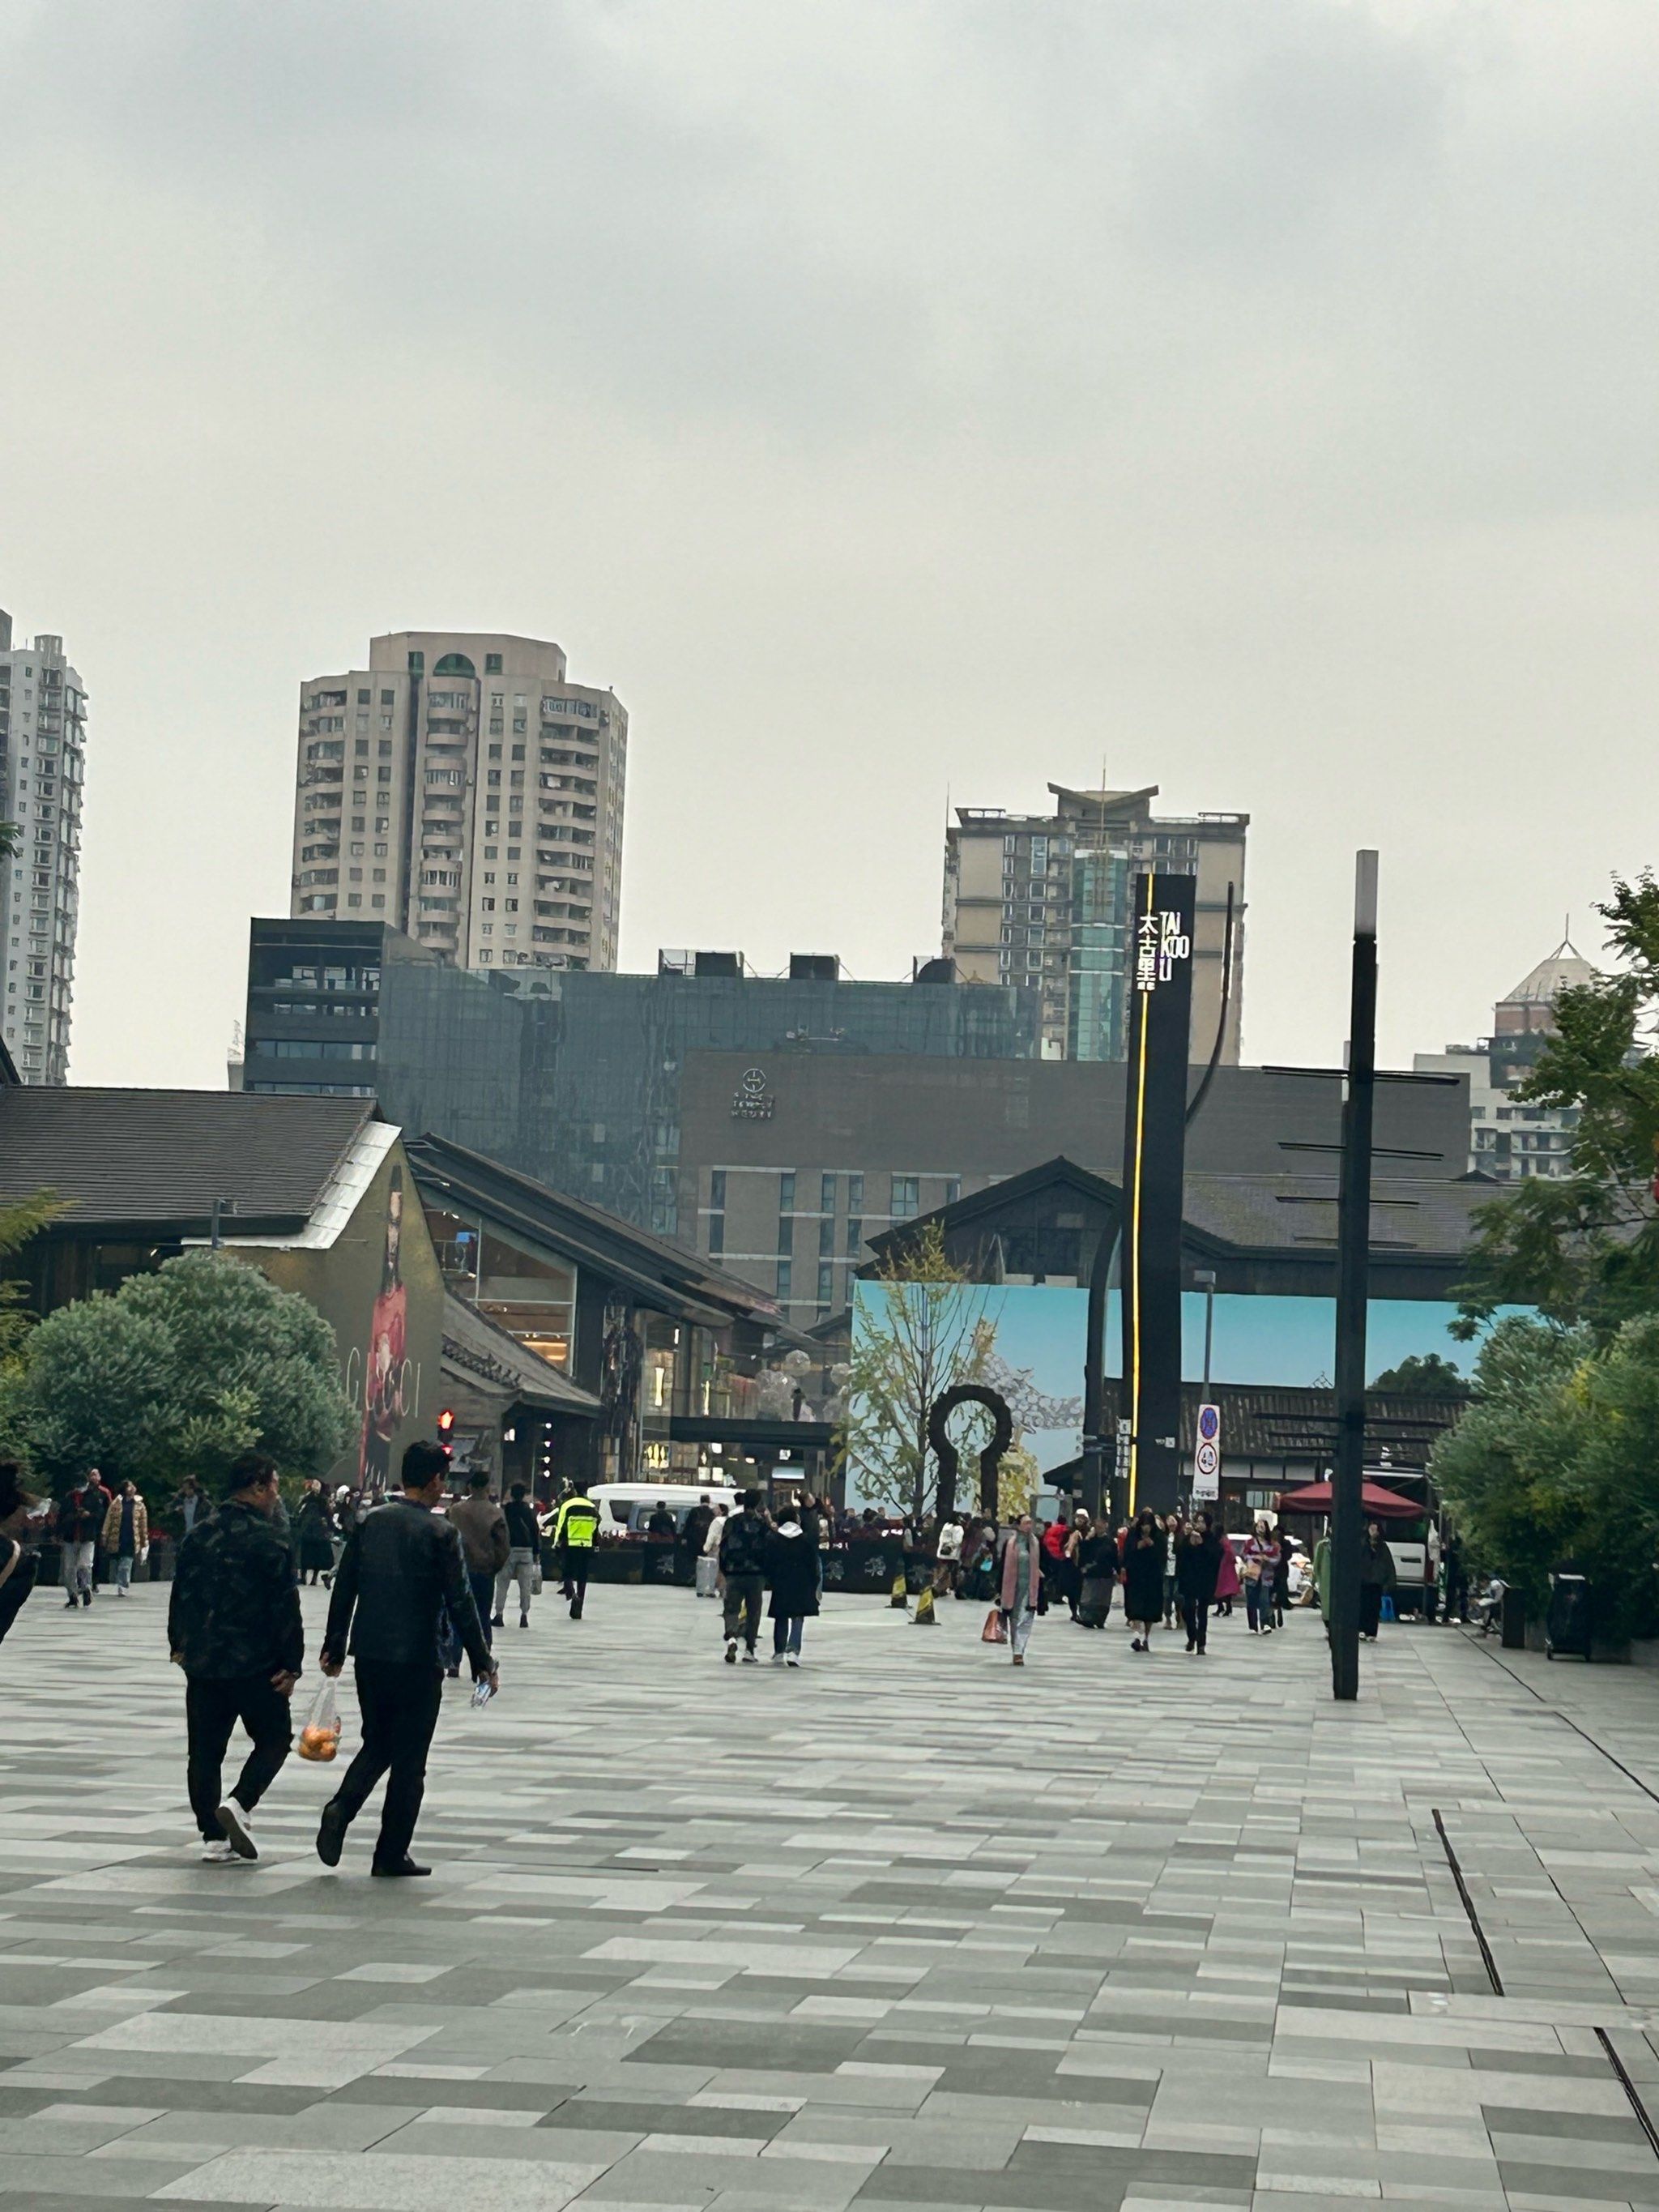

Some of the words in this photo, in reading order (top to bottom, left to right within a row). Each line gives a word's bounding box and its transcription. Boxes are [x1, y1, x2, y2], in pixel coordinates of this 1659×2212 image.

[1159, 912, 1180, 935] TAI
[1137, 914, 1158, 981] 太古里
[1160, 936, 1190, 959] KOO
[346, 1347, 420, 1418] GUCCI
